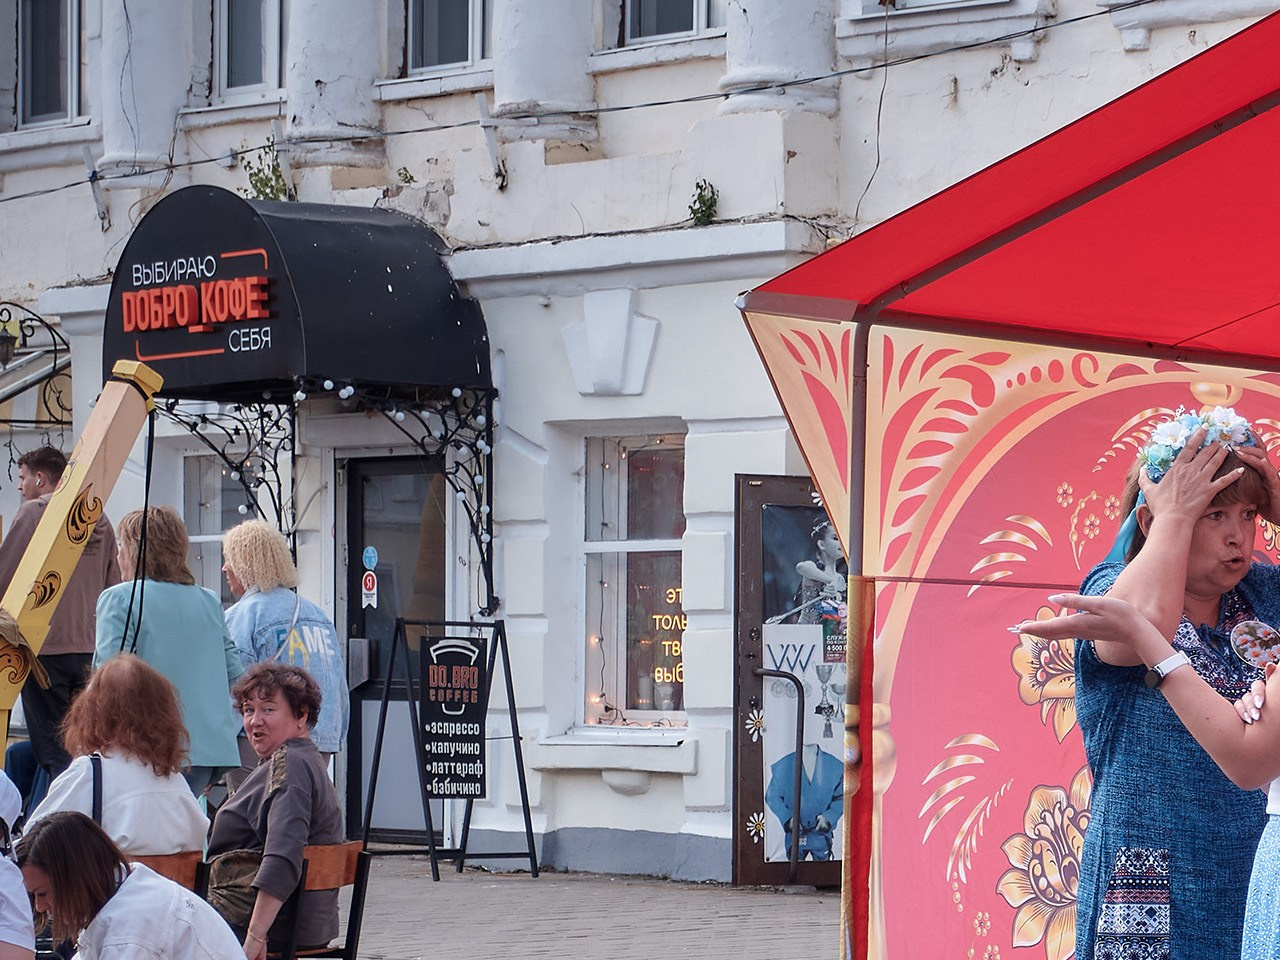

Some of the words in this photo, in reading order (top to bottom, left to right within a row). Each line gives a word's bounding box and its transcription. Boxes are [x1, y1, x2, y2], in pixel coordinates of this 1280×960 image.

[132, 255, 216, 287] ВЫБИРАЮ
[228, 327, 272, 353] СЕБЯ
[428, 665, 479, 689] DO.BRO
[429, 689, 478, 704] COFFEE
